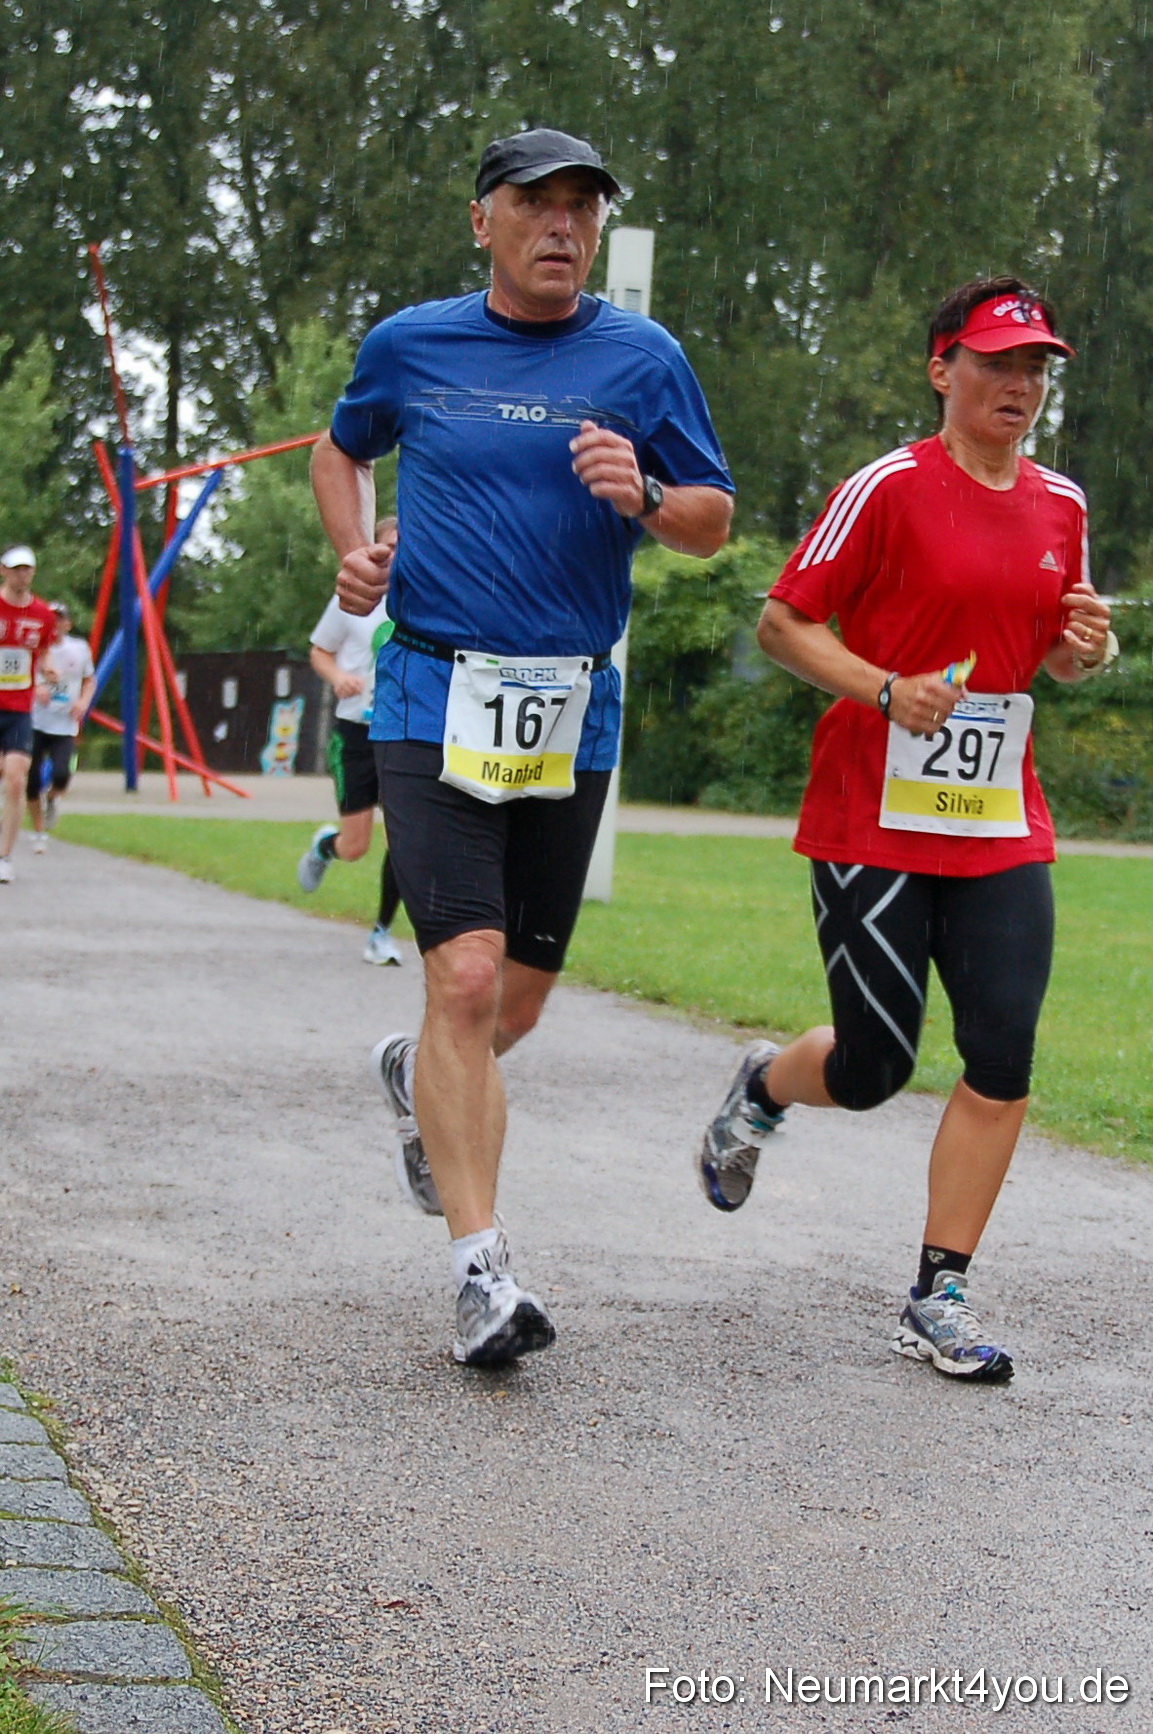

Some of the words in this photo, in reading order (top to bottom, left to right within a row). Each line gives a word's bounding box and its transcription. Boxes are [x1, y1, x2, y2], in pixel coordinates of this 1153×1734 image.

[498, 403, 547, 422] TAO
[484, 694, 569, 750] 167
[921, 725, 1005, 782] 297
[935, 791, 984, 815] Silvia
